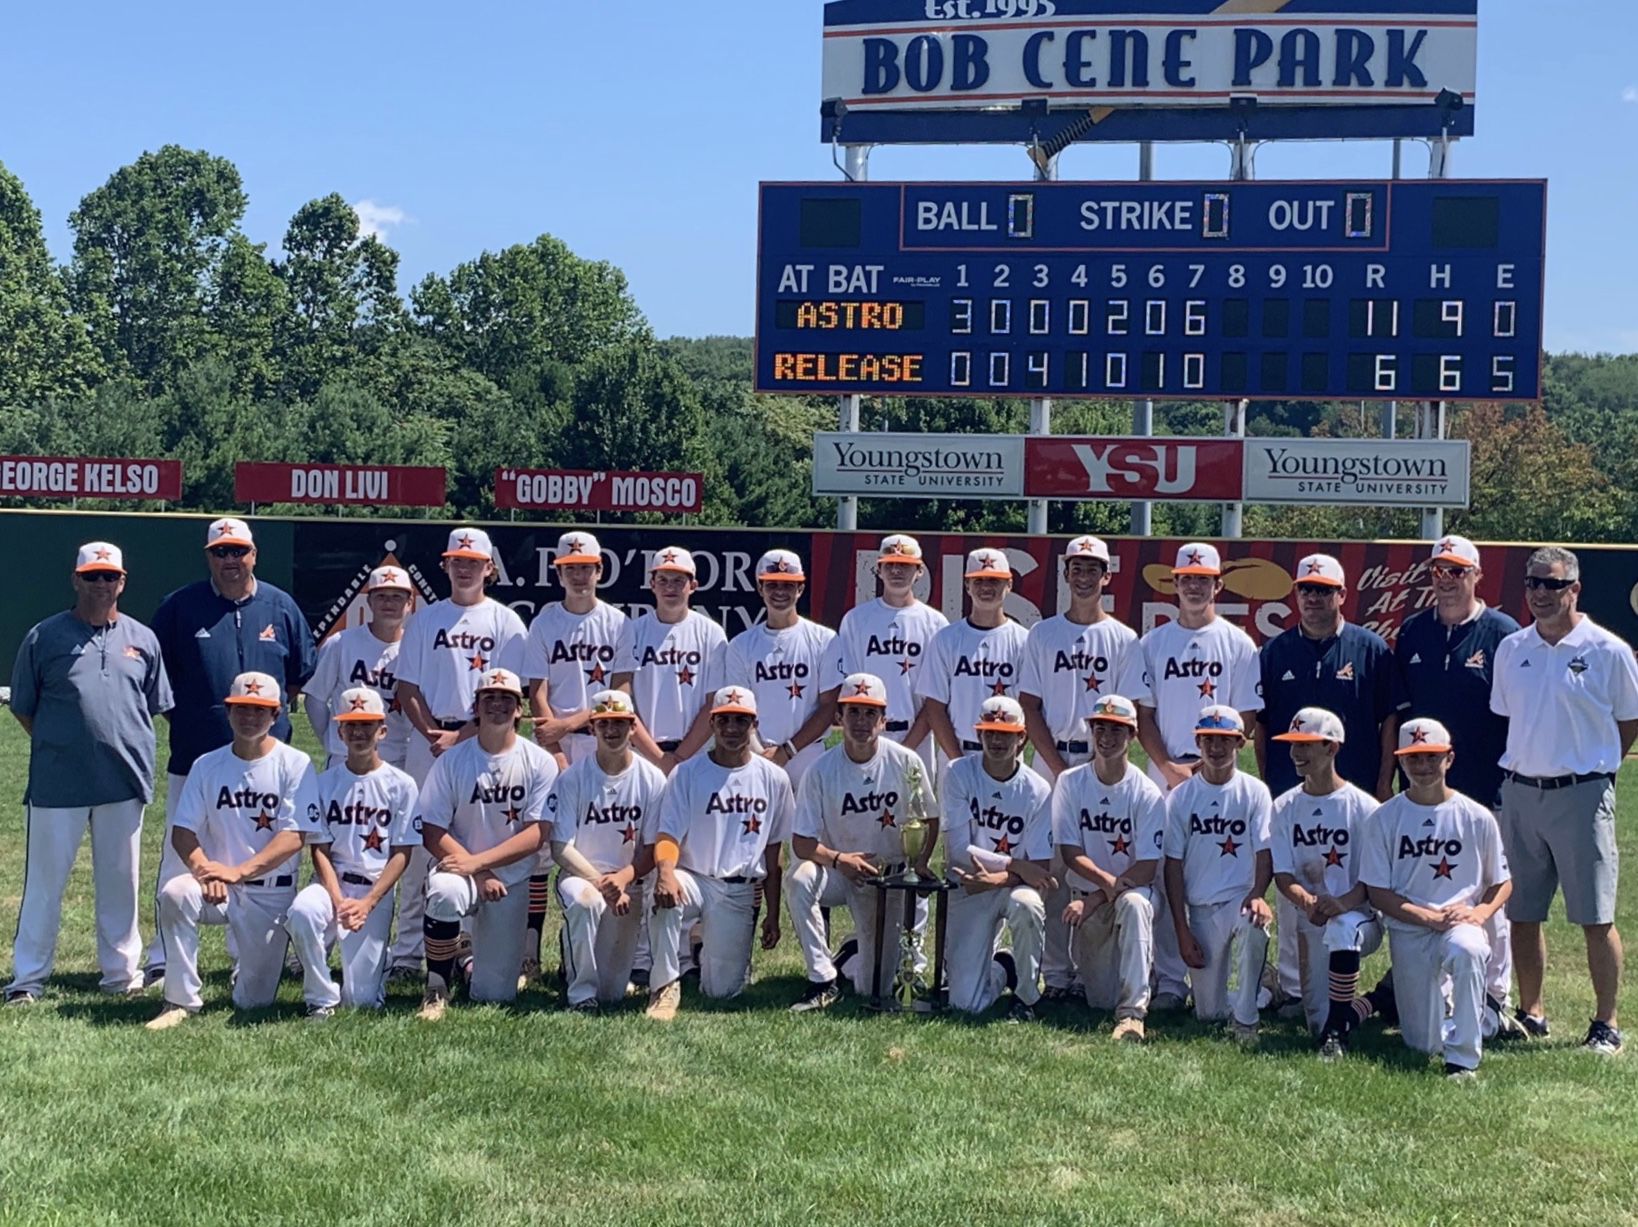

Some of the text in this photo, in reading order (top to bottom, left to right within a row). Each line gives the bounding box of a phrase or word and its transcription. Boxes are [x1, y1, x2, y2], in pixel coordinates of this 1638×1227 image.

[925, 0, 981, 19] Est.
[861, 28, 1428, 95] BOB CENE PARK
[917, 192, 1373, 238] BALL 0 STRIKE 0 OUT 0
[777, 264, 884, 294] AT BAT
[956, 264, 1515, 289] 1 2 3 4 5 6 7 8 9 10 R H E
[797, 300, 1516, 336] ASTRO 3 0 0 0 2 0 6 11 9 0
[774, 353, 923, 381] RELEASE
[950, 352, 971, 385] 0
[989, 353, 1010, 386] 0
[1028, 353, 1048, 386] 4
[1106, 354, 1126, 387] 0
[1183, 354, 1204, 388] 0
[1374, 355, 1396, 390] 6
[1439, 356, 1461, 390] 6
[1492, 357, 1514, 391] 5
[833, 442, 1004, 477] Youngstown
[1071, 444, 1197, 494] YSU
[1264, 448, 1447, 484] Youngstown
[1, 461, 159, 494] EORGE KELSO
[291, 468, 388, 500] DON LIVI
[865, 474, 1004, 486] STATE UNIVERSITY
[1298, 481, 1447, 494] STATE UNIVERSITY
[611, 476, 696, 507] MOSCO
[312, 563, 373, 639] EPENDABLE
[407, 563, 438, 603] CONST
[1365, 588, 1410, 616] At
[433, 628, 495, 652] Astro
[550, 639, 614, 664] Astro
[866, 634, 922, 657] Astro
[641, 645, 701, 667] Astro
[954, 655, 1014, 678] Astro
[1054, 650, 1109, 673] Astro
[1164, 656, 1223, 681] Astro
[350, 659, 397, 691] Astr
[755, 661, 809, 683] Astro
[216, 785, 279, 810] Astro
[469, 781, 526, 804] Astro
[705, 792, 767, 815] Astro
[841, 791, 899, 816] Astro
[326, 799, 392, 827] Astro
[584, 801, 642, 825] Astro
[970, 797, 1025, 835] Astro
[1080, 808, 1132, 834] Astro
[1190, 813, 1246, 836] Astro
[1293, 823, 1349, 847] Astro
[1398, 834, 1462, 860] Astro
